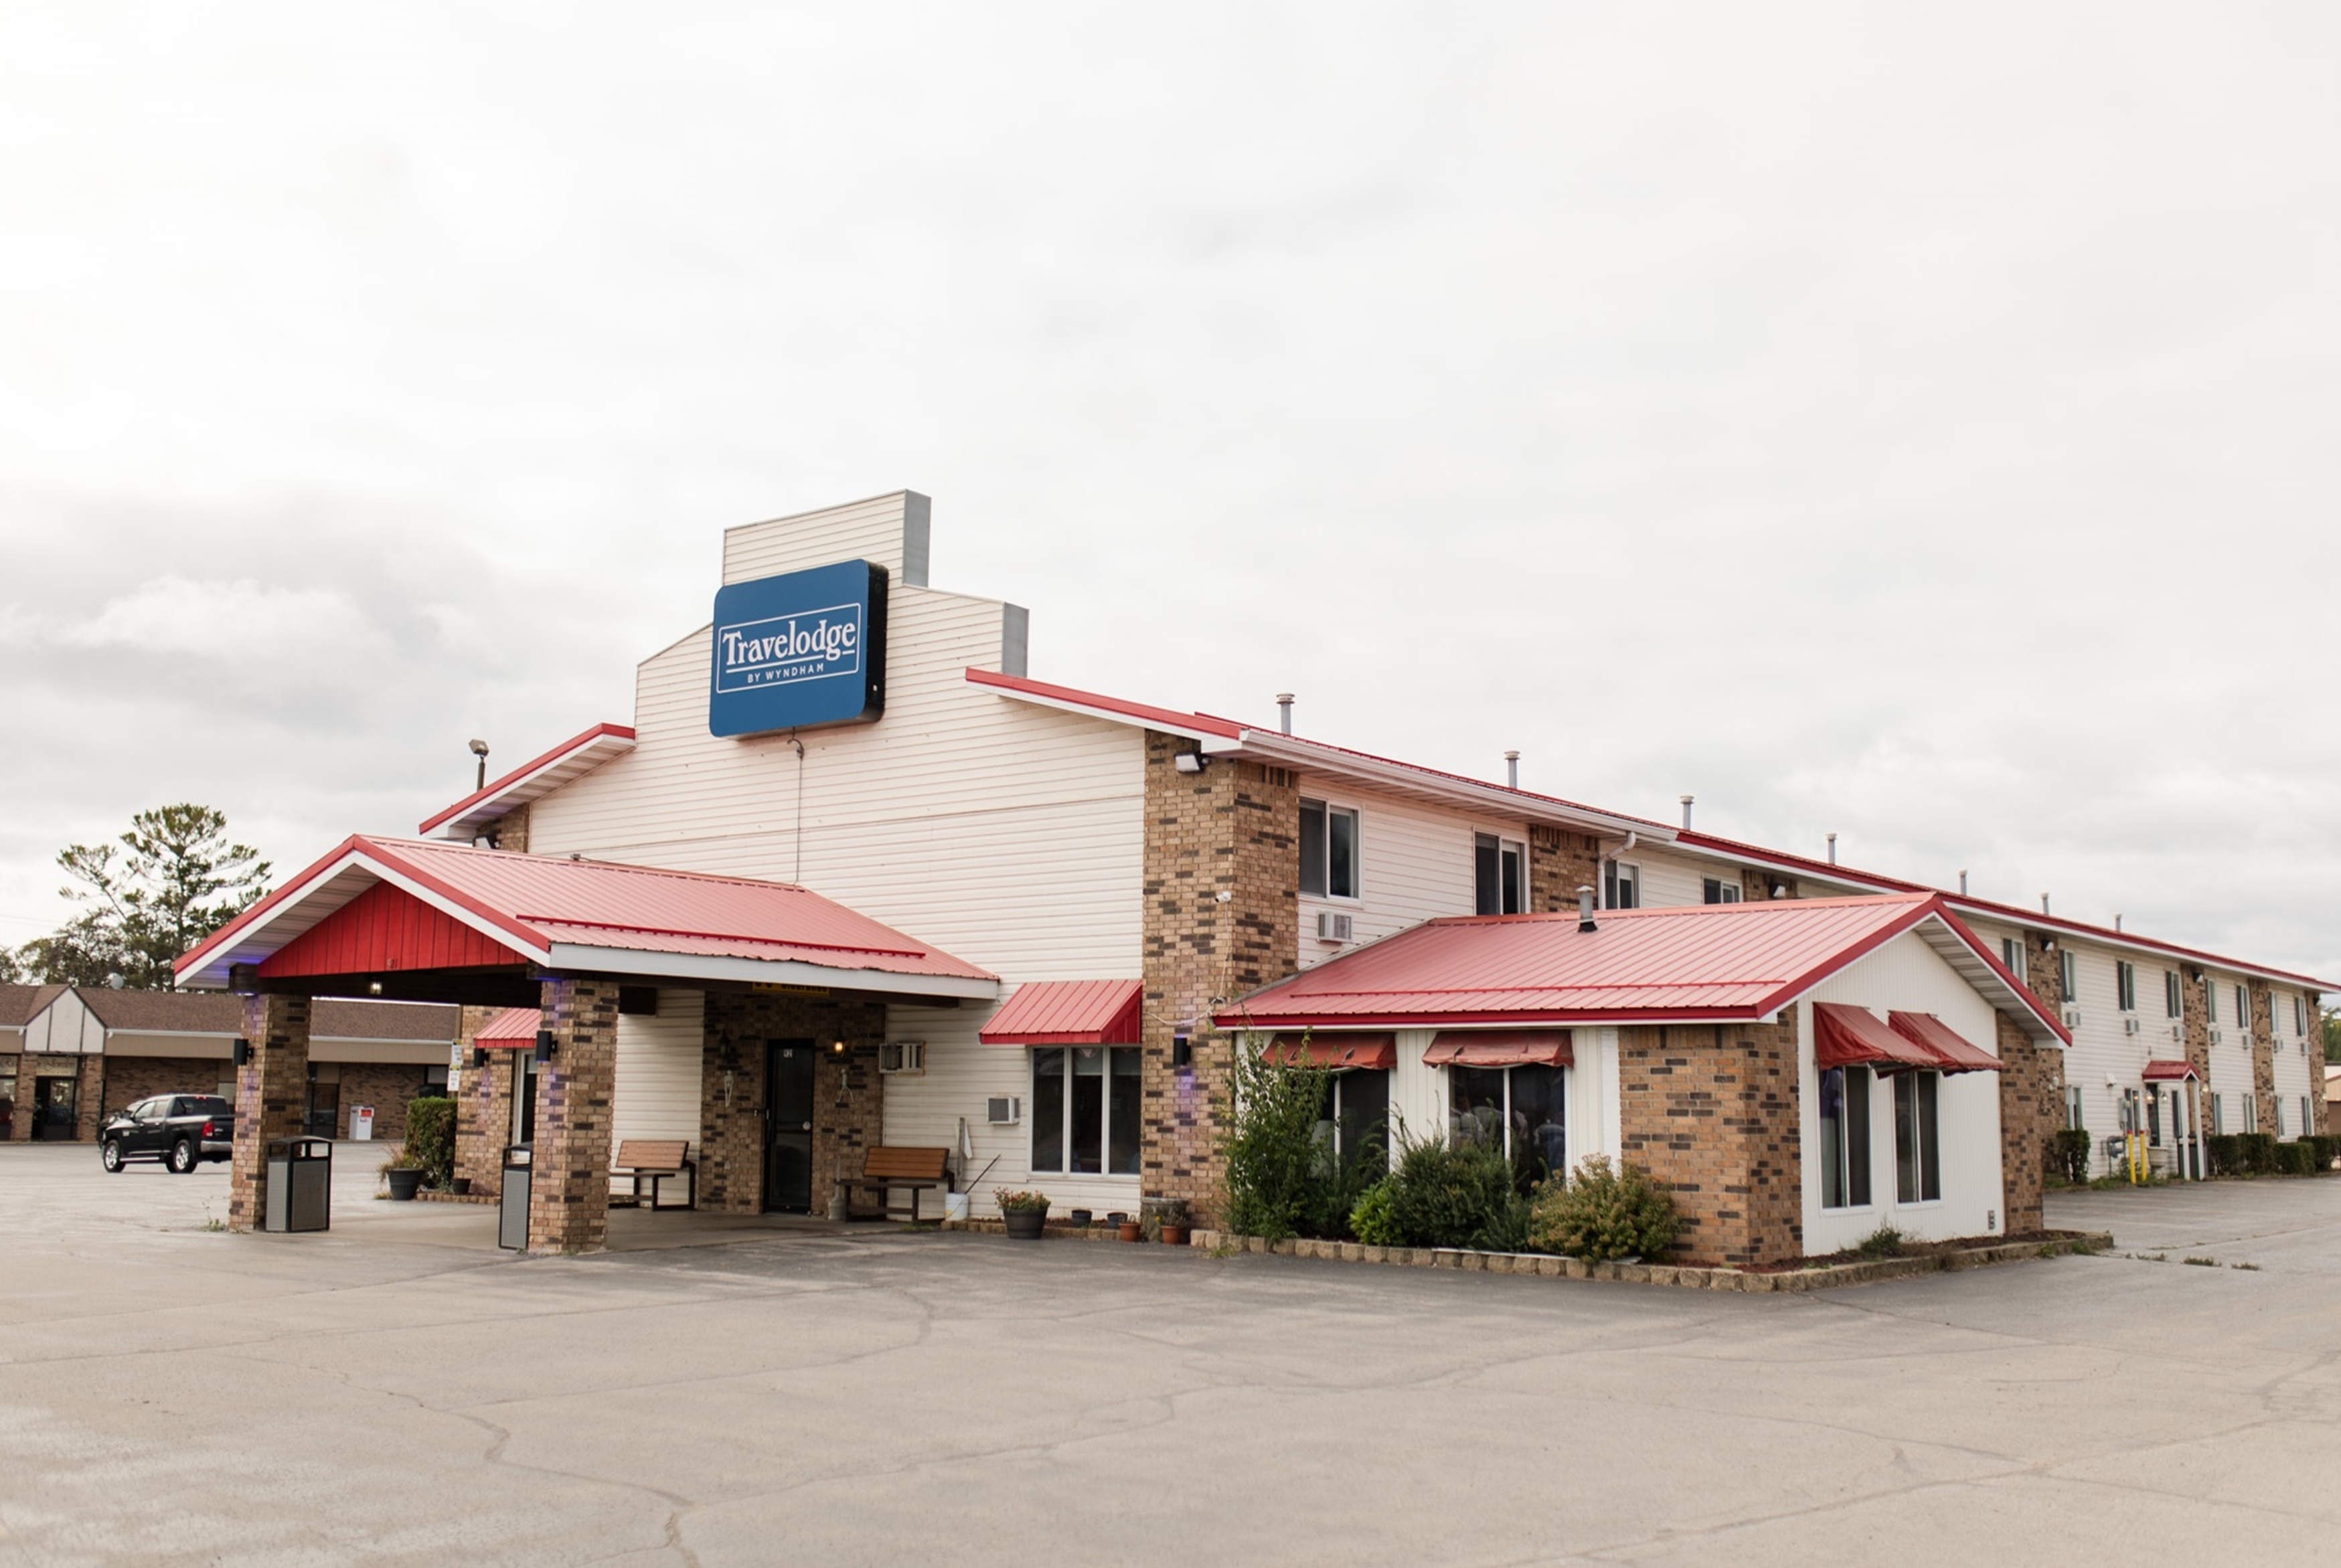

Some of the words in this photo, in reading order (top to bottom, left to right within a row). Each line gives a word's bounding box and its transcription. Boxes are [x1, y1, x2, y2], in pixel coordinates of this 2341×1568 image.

[722, 620, 856, 665] Travelodge
[748, 673, 760, 683] BY
[766, 663, 824, 680] WYNDHAM
